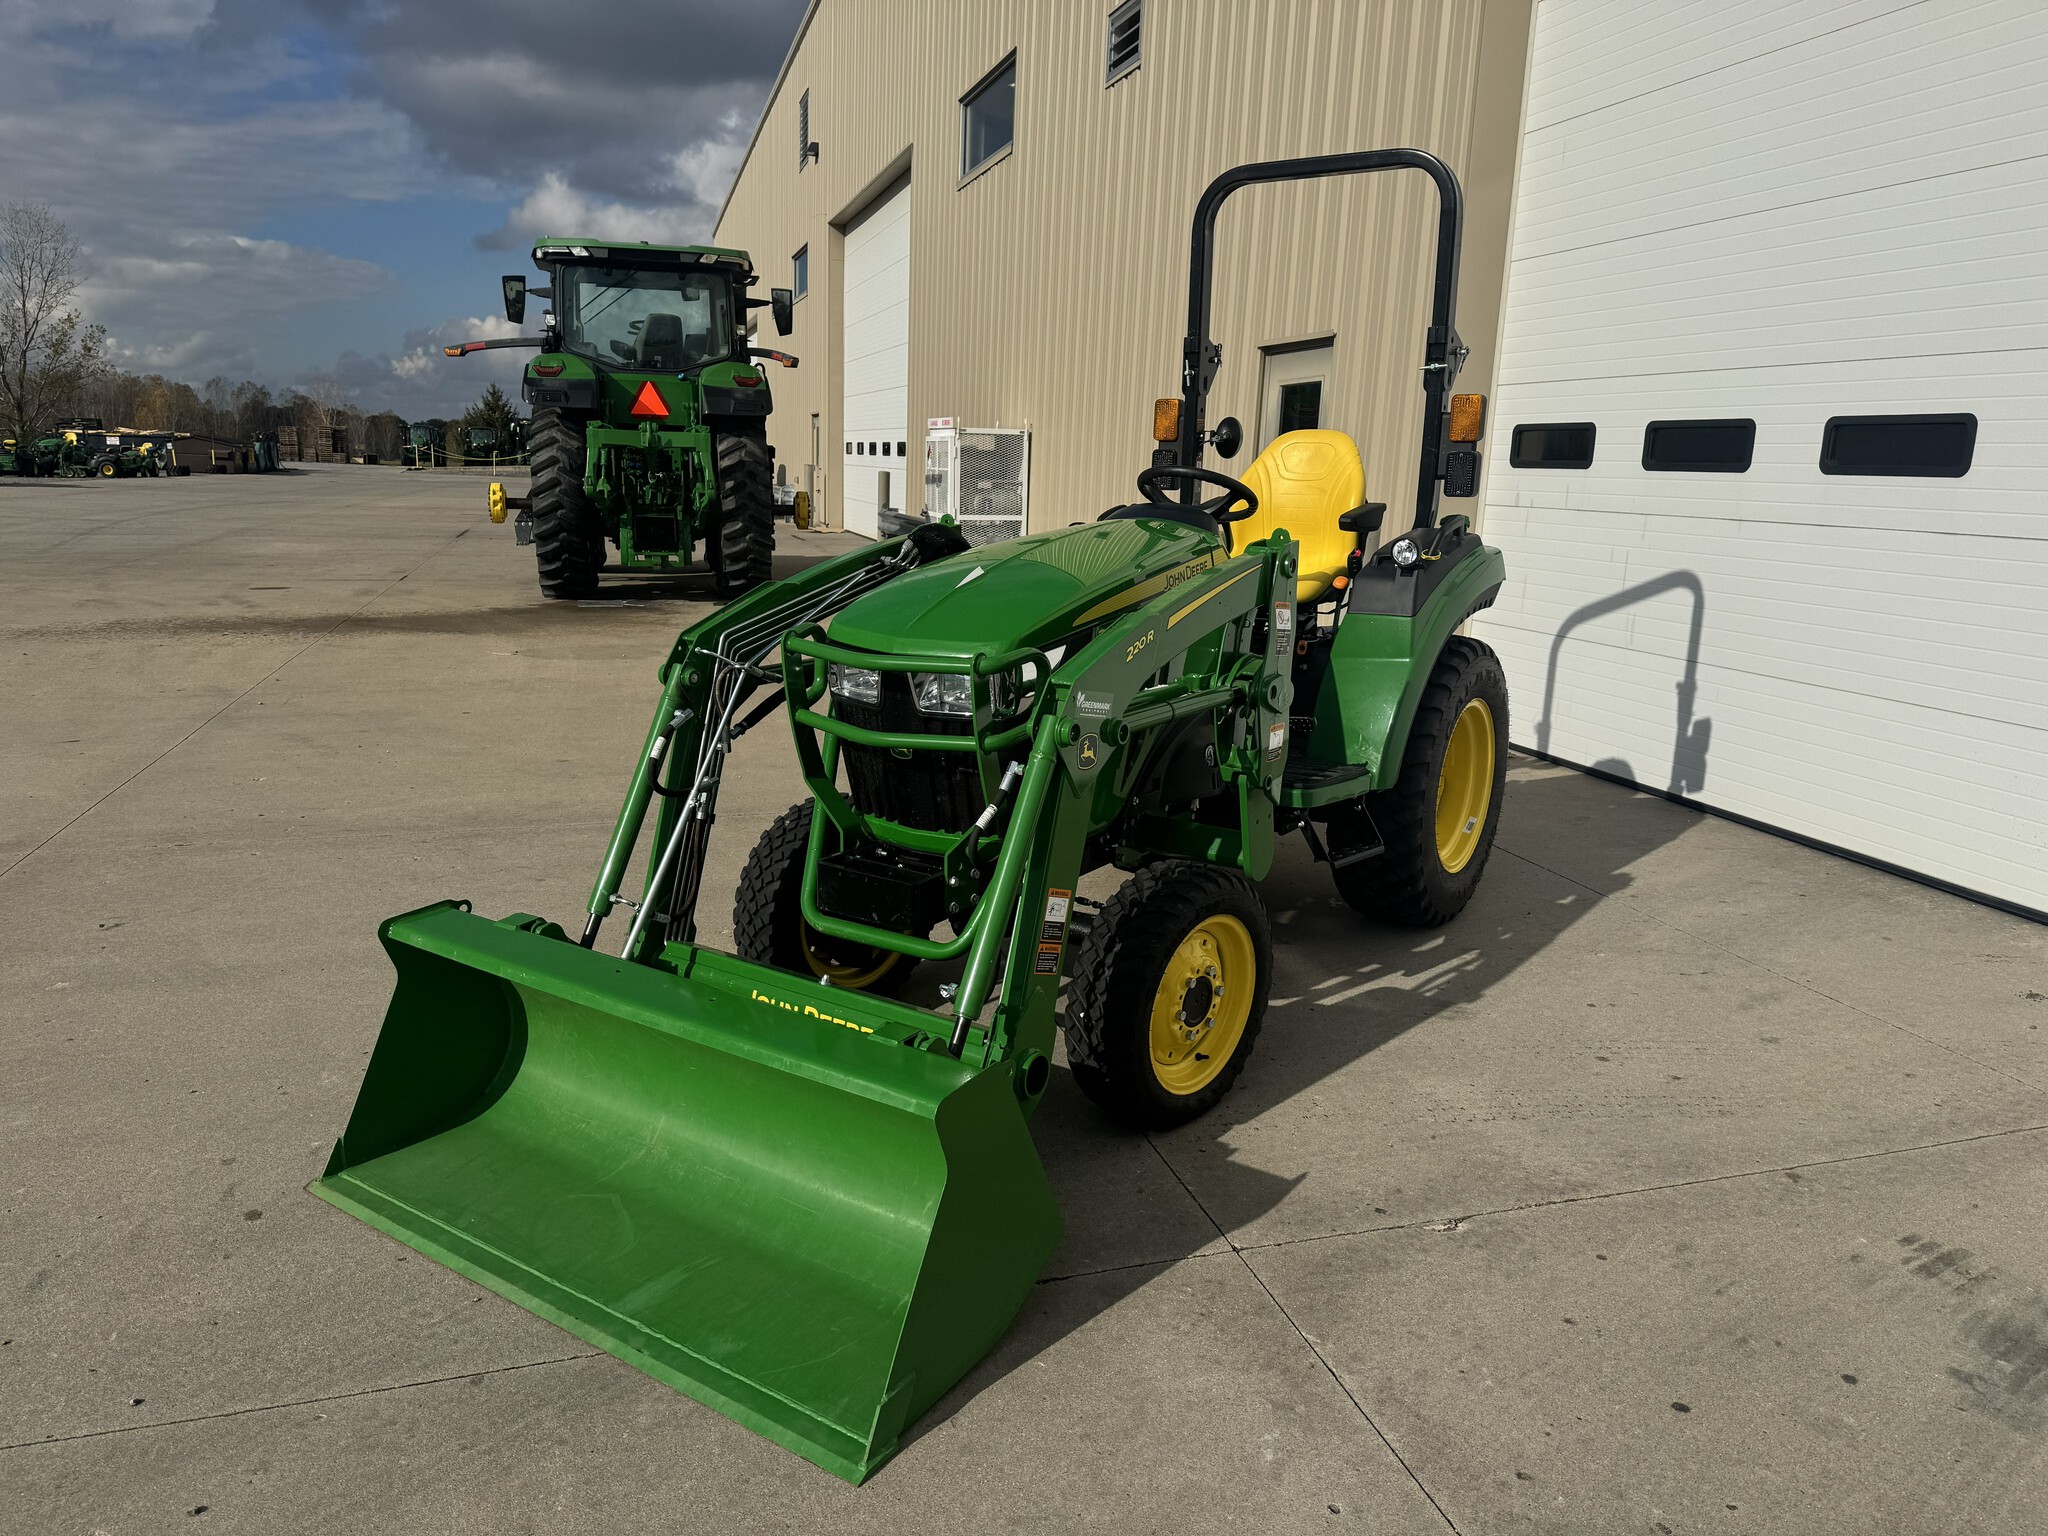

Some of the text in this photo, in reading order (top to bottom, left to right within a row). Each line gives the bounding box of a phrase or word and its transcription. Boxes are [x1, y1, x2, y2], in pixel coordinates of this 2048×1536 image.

[1164, 560, 1208, 590] JOHN DEERE
[1081, 700, 1111, 710] GREENMARK
